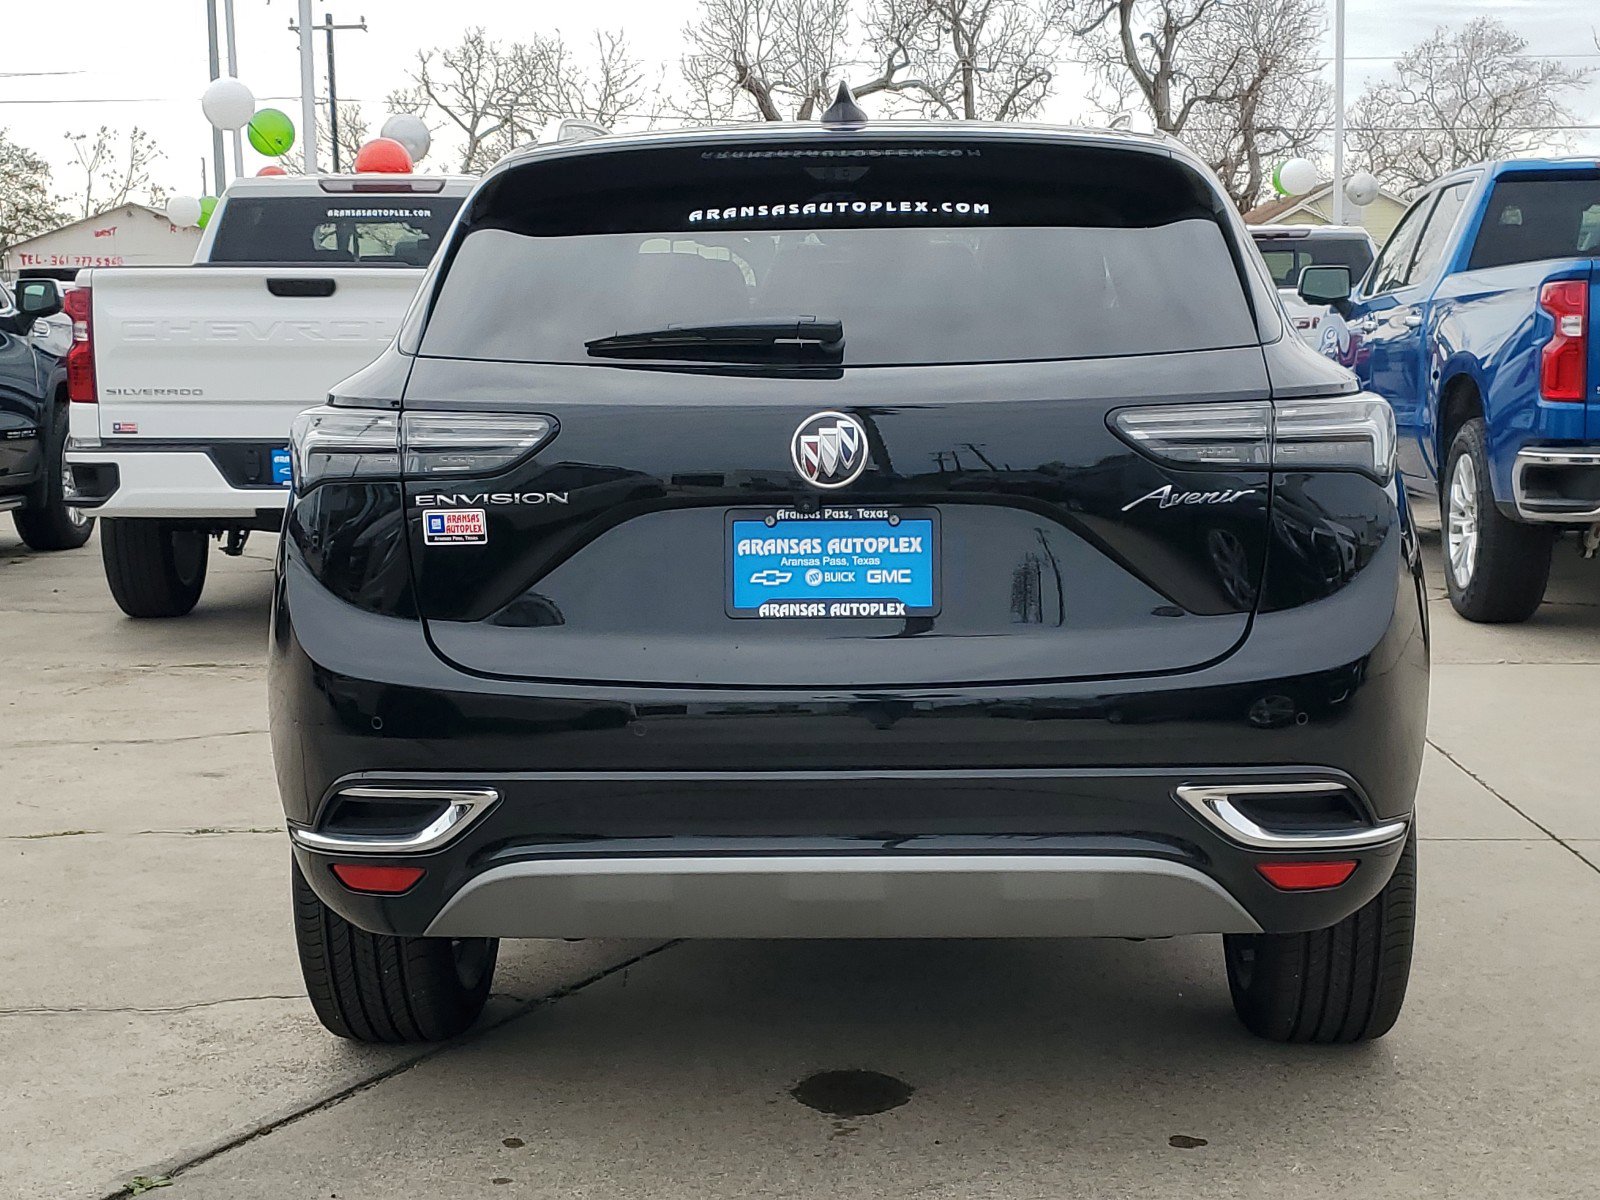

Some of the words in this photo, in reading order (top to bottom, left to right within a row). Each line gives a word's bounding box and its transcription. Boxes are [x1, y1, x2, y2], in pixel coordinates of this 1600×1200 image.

[327, 209, 431, 217] ARANSASAUTOPLEX.COM
[688, 201, 991, 222] ARANSASAUTOPLEX.COM
[51, 254, 70, 266] 361
[106, 388, 203, 396] SILVERADO
[415, 492, 569, 506] ENVISION
[1121, 484, 1256, 512] Avenir
[447, 514, 480, 524] ARANSAS
[824, 509, 853, 519] Pass,
[857, 509, 889, 518] Texas
[446, 524, 483, 534] AUTOPLEX
[738, 539, 822, 556] ARANSAS
[827, 537, 923, 555] AUTOPLEX
[780, 557, 820, 566] Aransas
[822, 556, 850, 567] Pass,
[851, 556, 880, 565] Texas
[824, 571, 856, 582] BUICK
[866, 569, 911, 583] GMC
[759, 604, 826, 618] ARANSAS
[830, 603, 906, 616] AUTOPLEX
